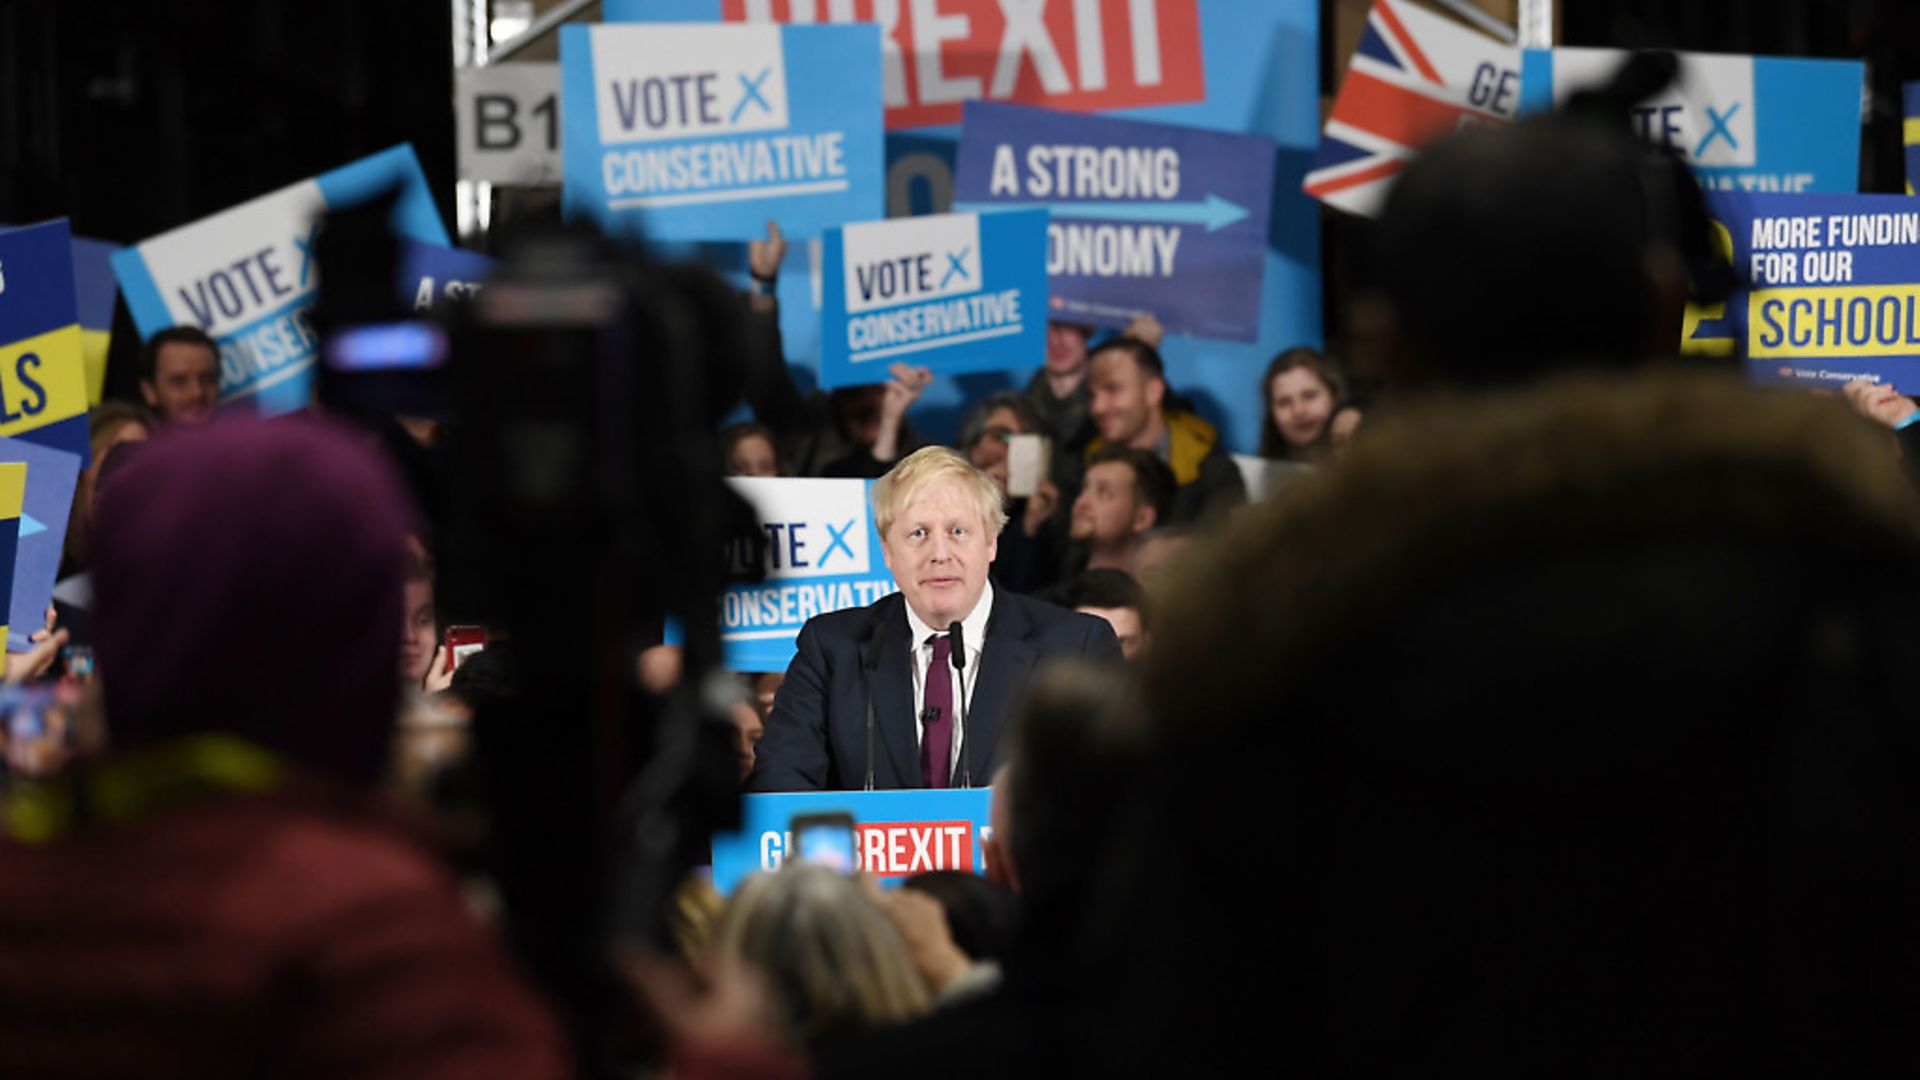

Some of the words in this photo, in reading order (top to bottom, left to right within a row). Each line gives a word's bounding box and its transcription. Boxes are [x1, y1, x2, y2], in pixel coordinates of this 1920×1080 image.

[612, 72, 720, 131] VOTE
[1468, 62, 1520, 115] GE
[475, 93, 558, 151] B1
[603, 131, 846, 196] CONSERVATIVE
[990, 144, 1019, 197] A
[1026, 144, 1180, 199] STRONG
[1046, 223, 1181, 277] ONOMY
[1752, 215, 1822, 249] MORE
[1827, 212, 1920, 248] FUNDIN
[179, 246, 292, 331] VOTE
[856, 252, 934, 302] VOTE
[1751, 251, 1798, 284] FOR
[1802, 251, 1852, 283] OUR
[848, 288, 1023, 351] CONSERVATIVE
